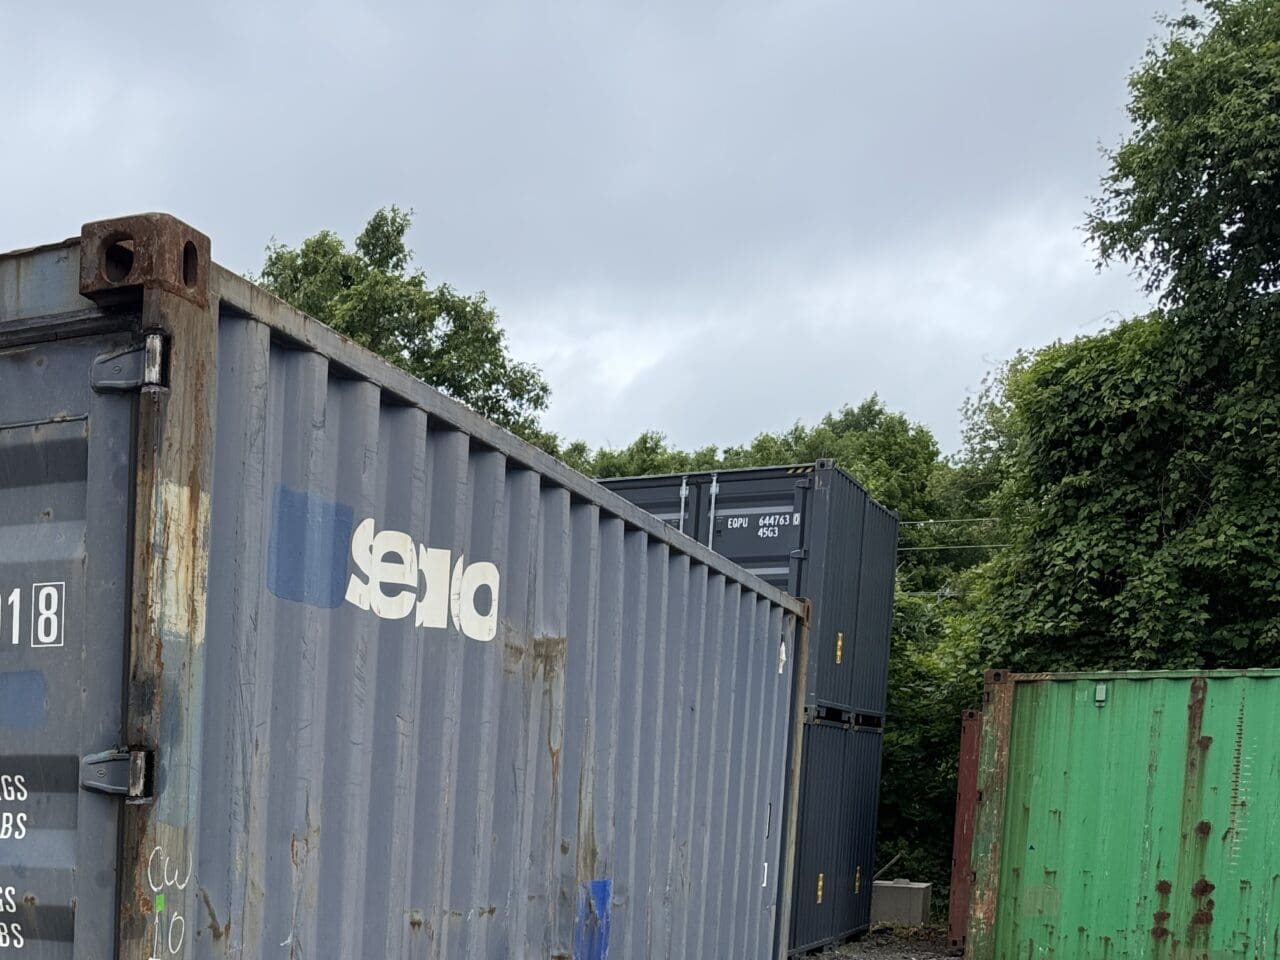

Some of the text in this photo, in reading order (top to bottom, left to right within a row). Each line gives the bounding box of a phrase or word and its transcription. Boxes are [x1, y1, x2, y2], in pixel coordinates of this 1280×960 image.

[758, 514, 790, 527] 644763
[757, 526, 779, 538] 45G3
[36, 586, 59, 644] 8
